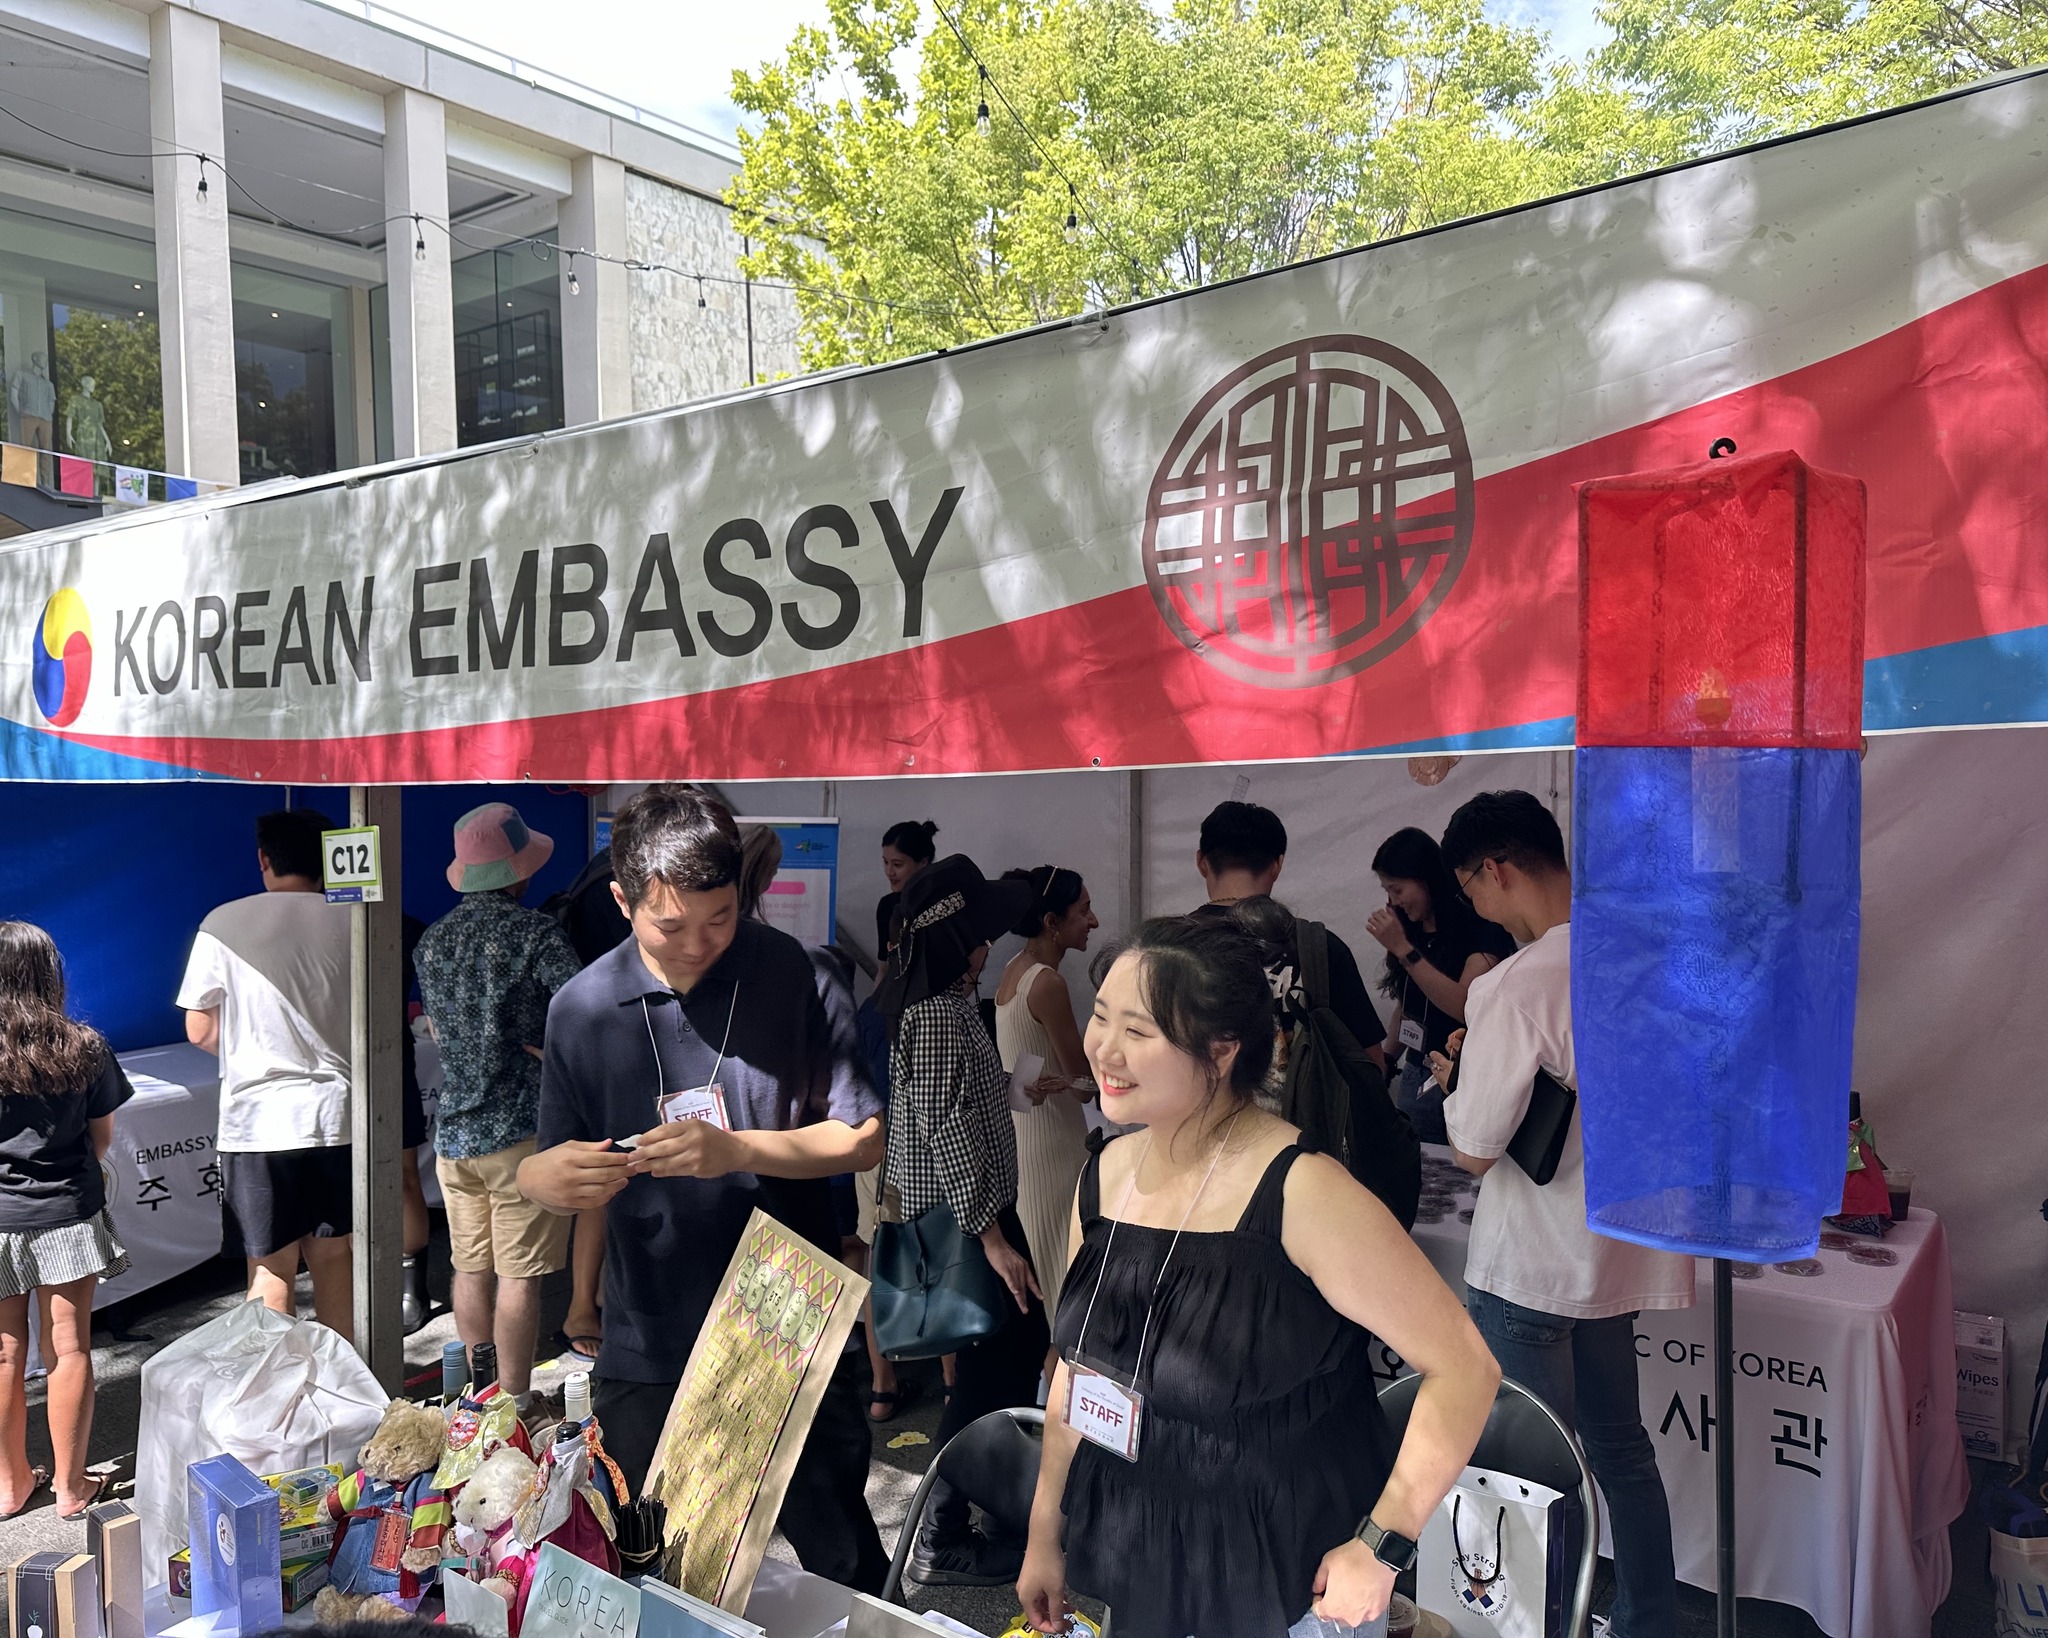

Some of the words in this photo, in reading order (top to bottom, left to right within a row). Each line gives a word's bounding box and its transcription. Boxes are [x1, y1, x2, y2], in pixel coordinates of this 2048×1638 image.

[114, 576, 374, 697] KOREAN
[410, 486, 963, 677] EMBASSY
[331, 844, 370, 876] C12
[1403, 1028, 1419, 1041] STAFF
[136, 1134, 217, 1164] EMBASSY
[1663, 1339, 1705, 1366] OF
[1732, 1350, 1828, 1393] OREA
[1079, 1396, 1124, 1428] STAFF
[1473, 1552, 1506, 1582] Strog
[540, 1566, 625, 1638] KOREA
[1486, 1594, 1508, 1617] COVID-19
